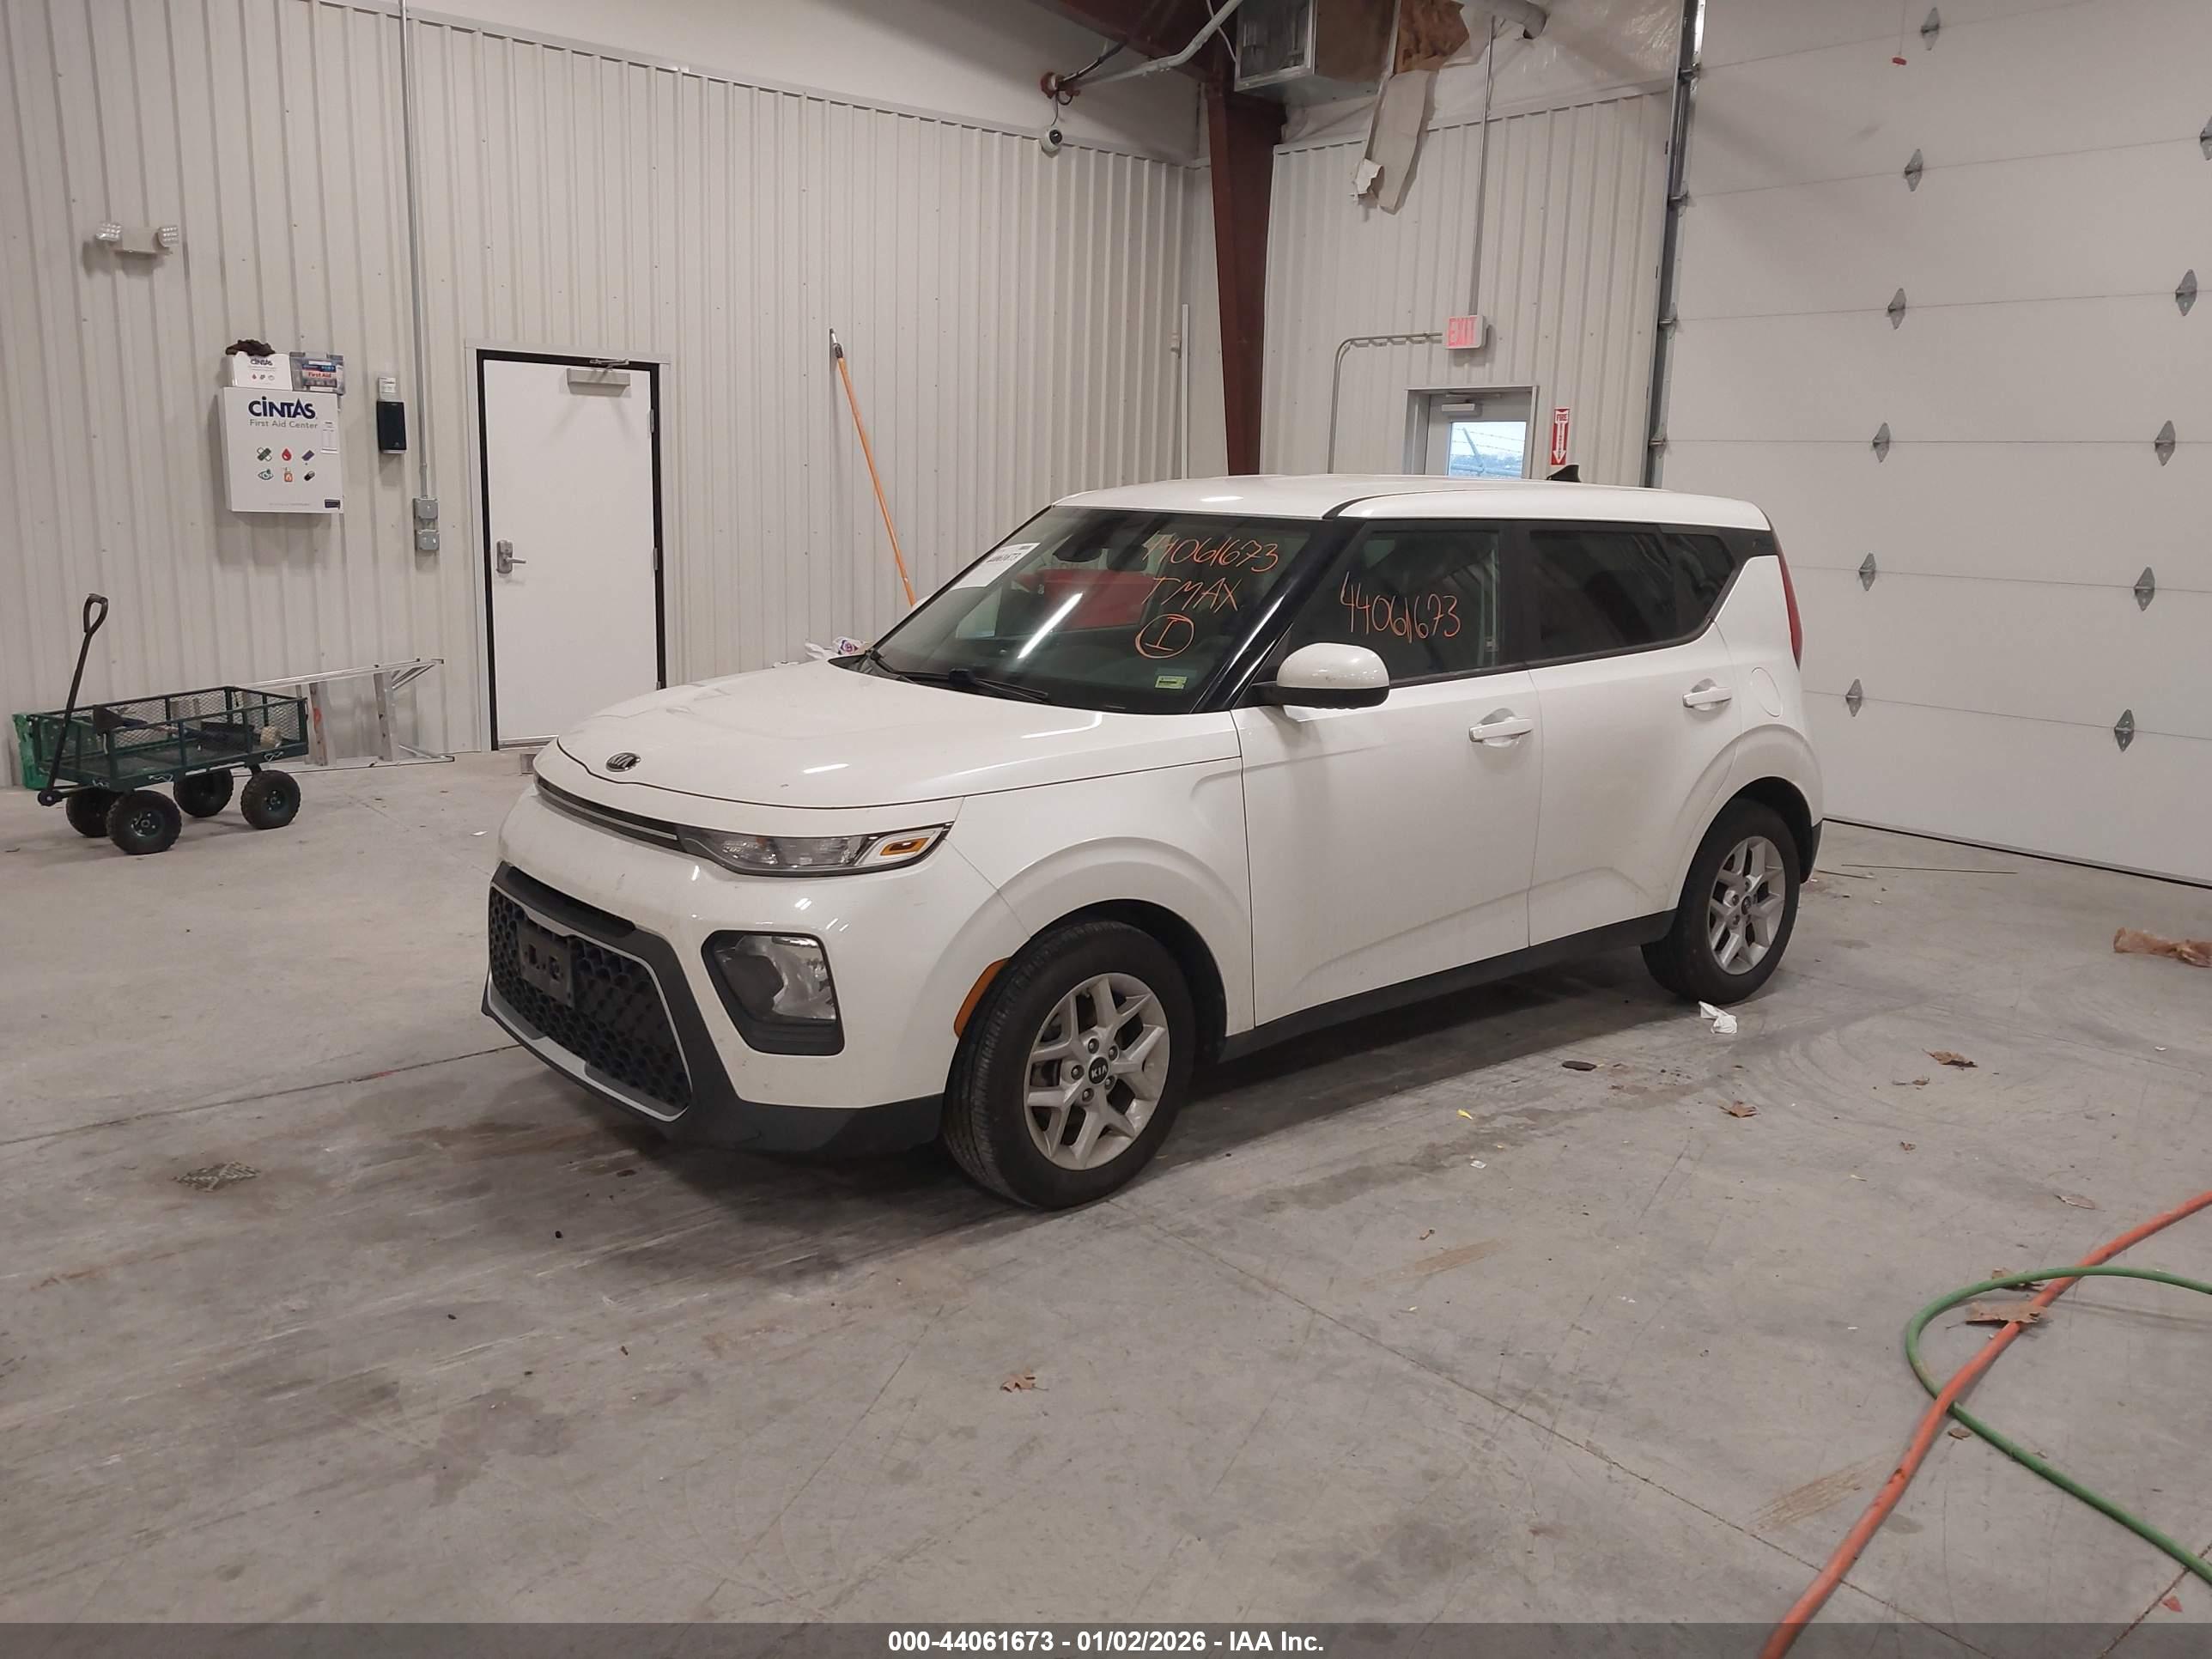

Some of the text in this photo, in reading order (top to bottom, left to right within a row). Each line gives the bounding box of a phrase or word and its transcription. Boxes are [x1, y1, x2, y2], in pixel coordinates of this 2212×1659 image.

[1449, 316, 1478, 345] EXIT
[1340, 571, 1462, 644] 44061673
[1091, 1064, 1108, 1079] KIA
